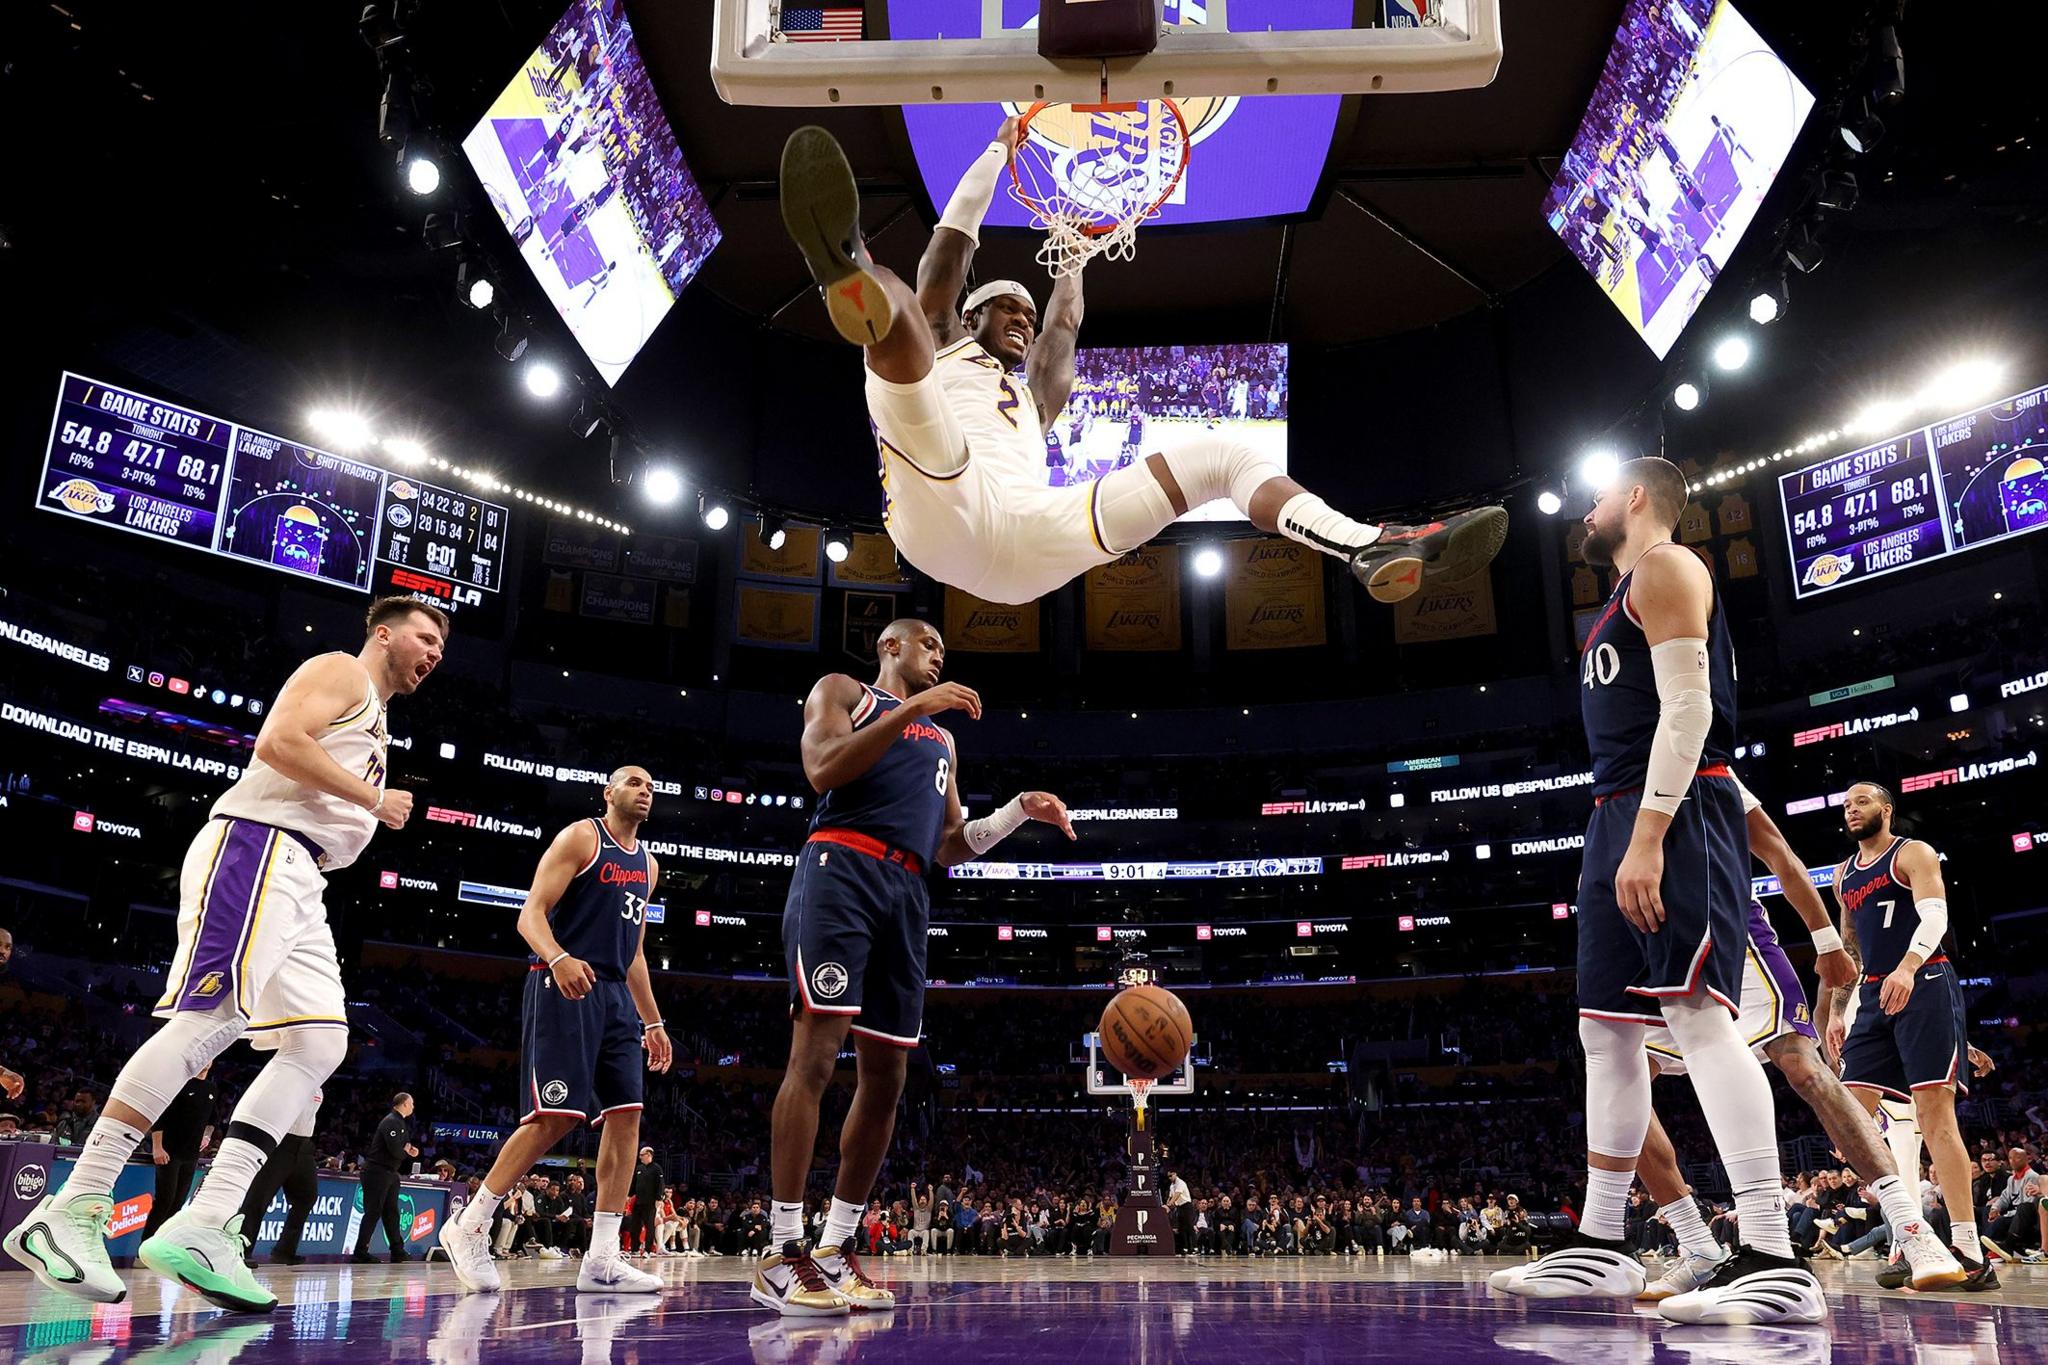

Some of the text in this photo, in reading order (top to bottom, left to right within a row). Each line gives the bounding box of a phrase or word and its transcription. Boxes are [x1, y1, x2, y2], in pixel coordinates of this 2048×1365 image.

[1391, 15, 1413, 28] NBA
[997, 376, 1019, 429] 2
[2015, 391, 2041, 412] SHOT
[100, 391, 200, 436] GAME STATS
[132, 424, 164, 441] TONIGHT
[1934, 415, 1977, 437] LOS ANGELES
[240, 431, 281, 451] LOS ANGELES
[1936, 427, 1972, 449] LAKERS
[61, 421, 220, 486] 54.8 47.1 68.1
[238, 440, 273, 460] LAKERS
[68, 452, 206, 500] FG% 3-PT% TS%
[316, 454, 377, 482] SHOT TRACKER
[1812, 444, 1898, 489] GAME STATS
[1843, 476, 1871, 493] TONIGHT
[128, 495, 192, 522] LOS ANGELES
[421, 491, 498, 528] 34 22 33 2 91
[1794, 472, 1929, 535] 54.8 47.1 68.1
[125, 508, 180, 536] LAKERS
[1687, 517, 1705, 531] 21
[1726, 511, 1745, 523] 42
[1806, 503, 1925, 549] FG% 3-PT% TS%
[418, 514, 498, 551] 28 15 34 7 84
[1863, 529, 1920, 557] LOS ANGELES
[426, 541, 457, 568] 9:01
[1247, 544, 1301, 563] LAKERS
[1865, 544, 1912, 572] LAKERS
[428, 562, 451, 575] QUARTER
[391, 569, 482, 607] ESPN LA
[1249, 607, 1305, 625] LAKERS
[1415, 595, 1473, 616] LAKERS
[965, 610, 1021, 631] LAKERS
[1104, 611, 1162, 629] LAKERS
[1583, 642, 1620, 690] 40
[1831, 683, 1873, 698] UCLA Health
[2001, 670, 2048, 699] FOLLO
[1793, 722, 1845, 747] ESPN
[1844, 717, 1864, 736] LA
[1871, 713, 1898, 730] 710
[1, 703, 239, 780] DOWNLOAD THE ESPN LA APP &
[363, 751, 385, 788] 77
[484, 752, 535, 775] FOLLOW
[535, 764, 555, 778] US
[1403, 757, 1441, 767] AMERICAN
[1408, 762, 1442, 771] EXPRESS
[934, 758, 949, 797] 8
[1901, 768, 1958, 794] ESPN
[1958, 763, 1980, 783] LA
[1989, 758, 2015, 776] 710
[1431, 786, 1482, 803] FOLLOW
[1483, 785, 1501, 798] US
[1261, 801, 1305, 816] ESPN
[1305, 800, 1322, 813] LA
[1327, 801, 1349, 812] 710
[96, 820, 141, 838] TOYOTA
[425, 806, 477, 828] ESPN
[475, 814, 493, 832] LA
[501, 822, 523, 836] 710
[679, 844, 794, 867] THE ESPN LA APP &
[1512, 835, 1585, 856] DOWNLOAD
[1110, 864, 1145, 879] 9:01
[1156, 868, 1164, 878] 4
[1173, 866, 1212, 877] Clippers
[1227, 863, 1246, 876] 84
[1341, 854, 1386, 871] ESPN
[1386, 852, 1402, 867] LA
[1408, 851, 1431, 865] 710
[400, 877, 438, 892] TOYOTA
[599, 861, 648, 888] Clippers
[620, 891, 647, 926] 33
[645, 909, 662, 921] ANK
[1876, 900, 1896, 929] 7
[712, 915, 747, 926] TOYOTA
[1313, 922, 1348, 934] TOYOTA
[1415, 915, 1451, 927] TOYOTA
[926, 927, 949, 937] YOTA
[1014, 929, 1048, 938] TOYOTA
[1113, 929, 1147, 939] TOYOTA
[1212, 927, 1247, 937] TOYOTA
[468, 1129, 499, 1141] ULTRA
[17, 1173, 44, 1190] bibigo
[122, 1204, 139, 1217] Live
[309, 1195, 344, 1217] NACK
[111, 1213, 149, 1232] Delicious
[301, 1222, 334, 1242] FANS
